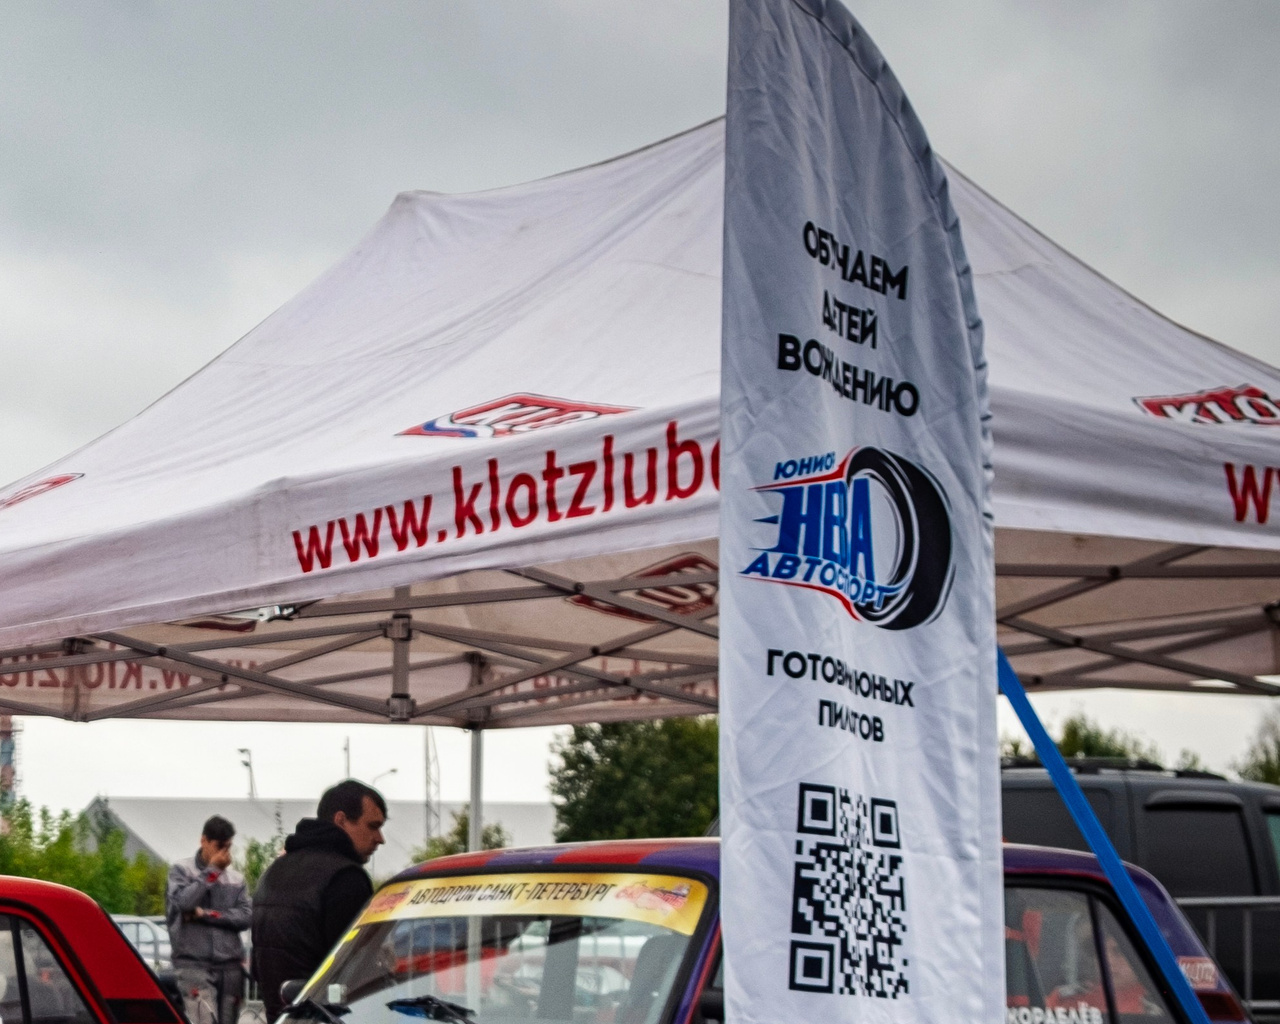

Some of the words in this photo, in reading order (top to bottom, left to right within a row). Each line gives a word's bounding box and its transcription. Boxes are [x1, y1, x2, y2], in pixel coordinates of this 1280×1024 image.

[822, 289, 877, 349] ДТЕЙ
[773, 452, 835, 481] ЮНИО
[1224, 462, 1280, 524] w
[754, 478, 876, 582] НВА
[767, 649, 855, 693] ГОТОВИ
[854, 670, 915, 707] ЮНЫХ
[407, 885, 482, 906] АВТОДРОМ
[478, 883, 616, 902] САНКТ-ПЕТЕРБУРГ
